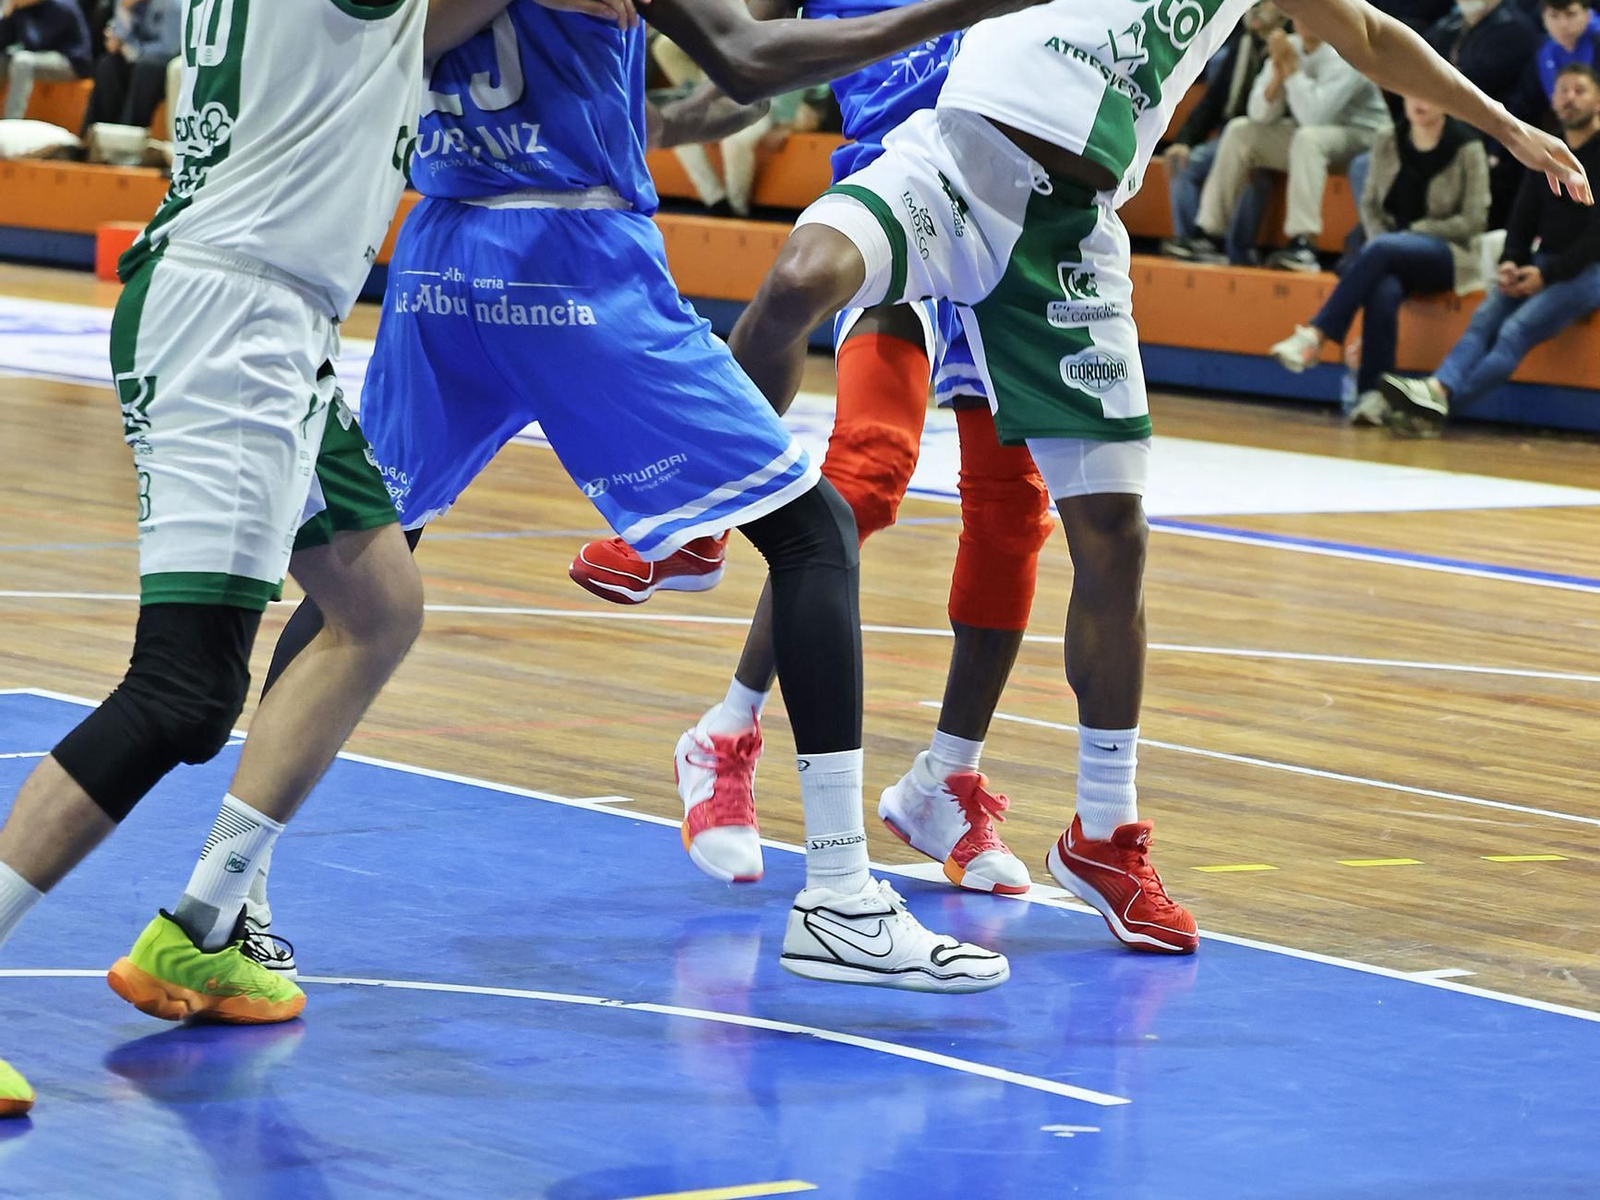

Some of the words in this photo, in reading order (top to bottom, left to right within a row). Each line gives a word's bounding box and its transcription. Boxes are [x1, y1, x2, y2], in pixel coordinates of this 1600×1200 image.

[411, 284, 597, 326] Abundancia
[612, 453, 688, 485] HYUNDAI
[812, 835, 865, 851] SPALDIN
